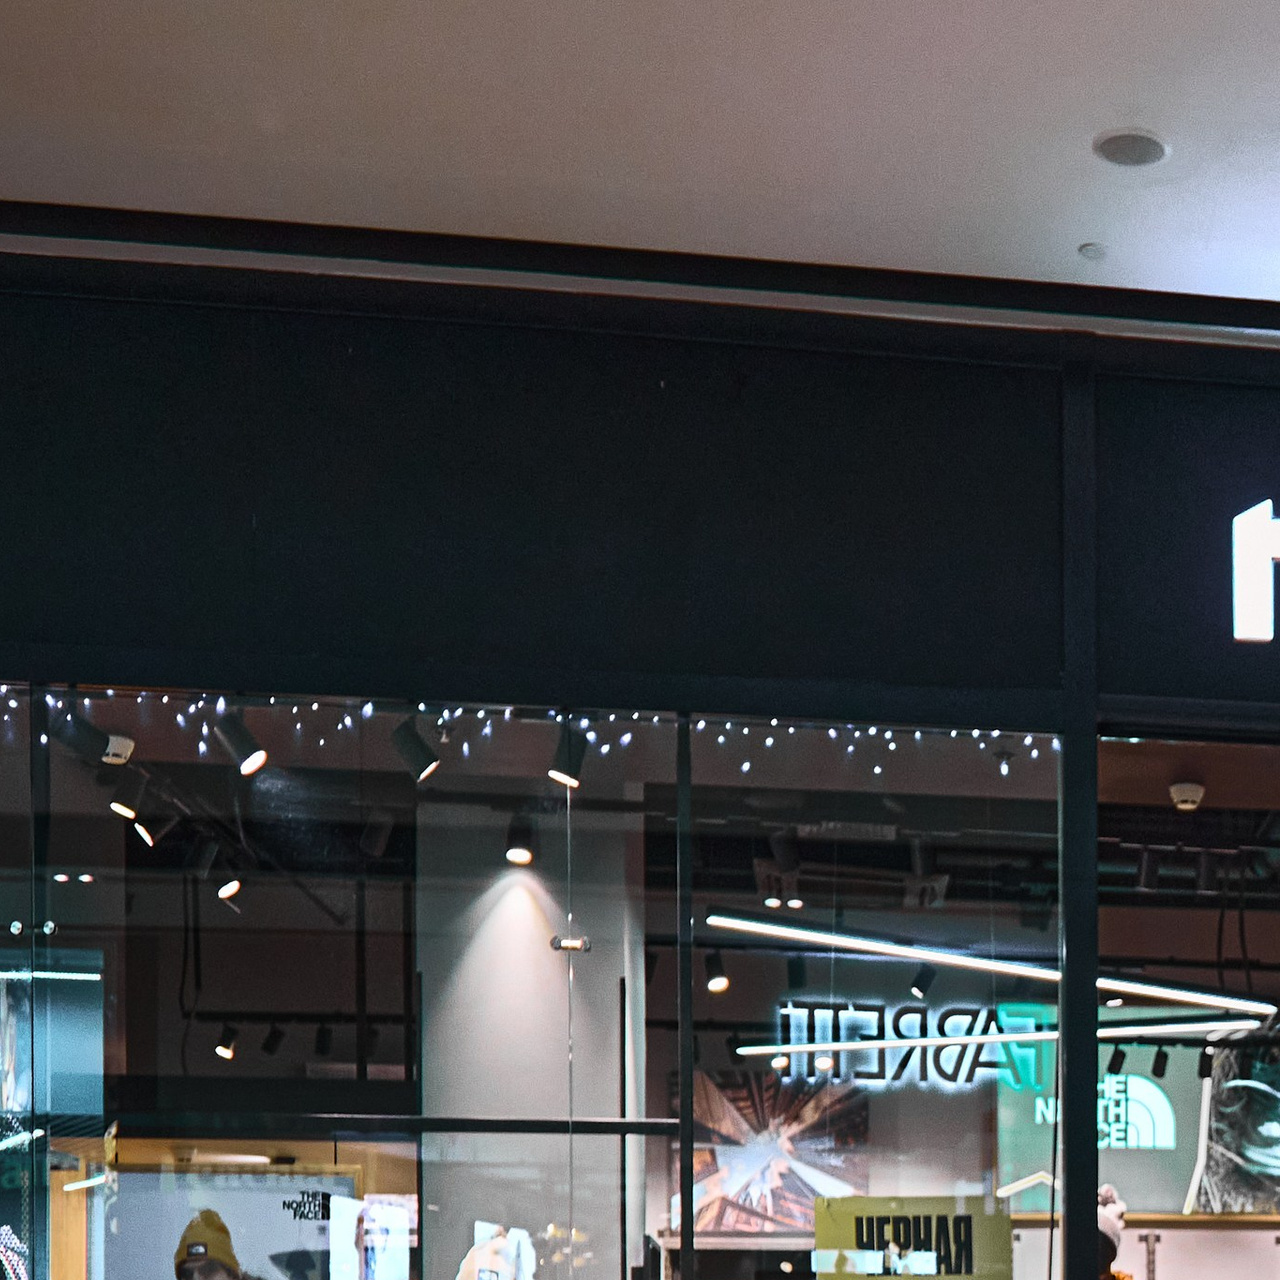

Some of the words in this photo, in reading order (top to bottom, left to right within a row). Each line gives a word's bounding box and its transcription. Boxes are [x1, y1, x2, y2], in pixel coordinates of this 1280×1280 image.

[1097, 1074, 1127, 1100] HE
[1097, 1122, 1127, 1149] CE
[300, 1190, 320, 1201] THE
[282, 1200, 320, 1211] NORTH
[293, 1210, 320, 1221] FACE
[854, 1215, 973, 1276] ЧЕРНАЯ
